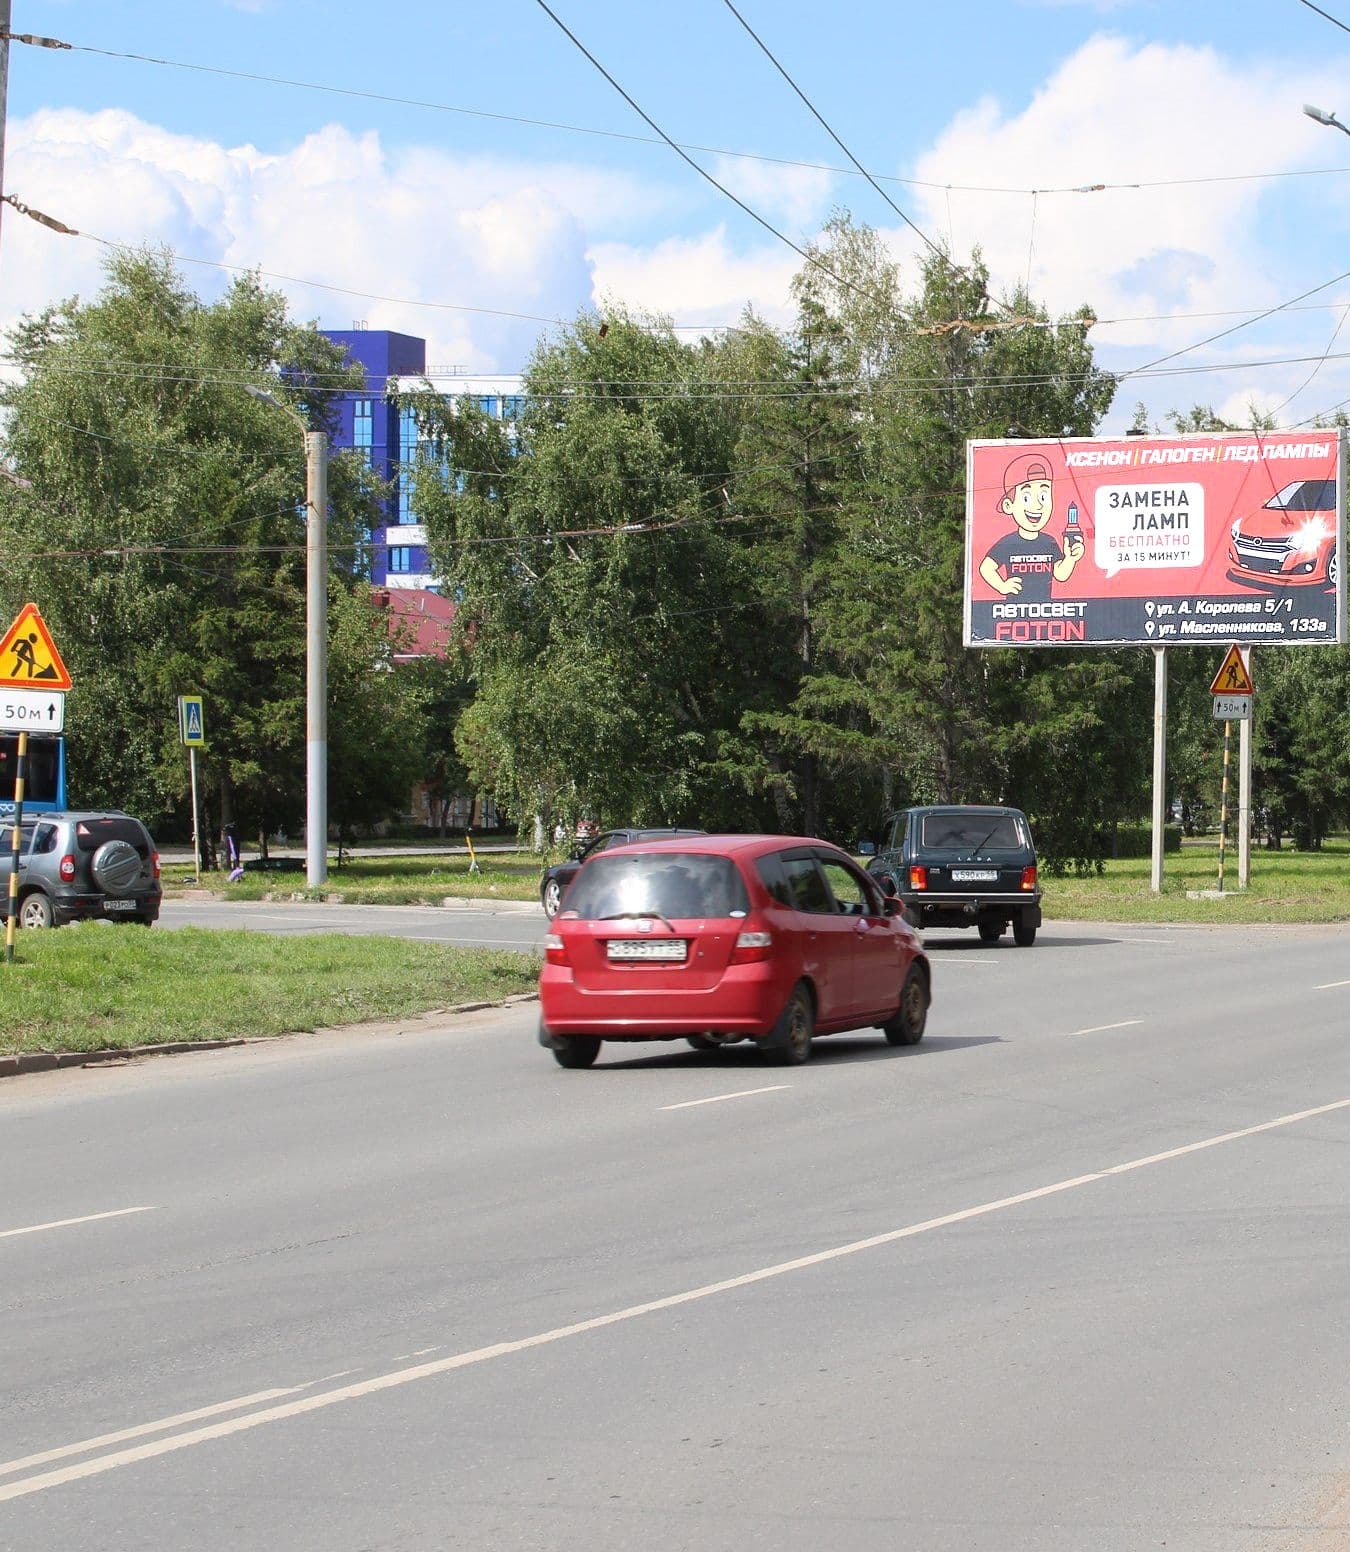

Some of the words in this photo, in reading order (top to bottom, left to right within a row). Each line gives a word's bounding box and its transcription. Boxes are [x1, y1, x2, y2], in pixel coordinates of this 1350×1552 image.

[1065, 451, 1132, 467] КСЕНОН
[1140, 447, 1217, 465] ГАЛОГЕН
[1223, 445, 1260, 462] ЛЕД
[1261, 443, 1330, 460] ЛАМПЫ
[1109, 490, 1189, 508] ЗАМЕНА
[1133, 512, 1188, 530] ЛАМП
[1109, 534, 1190, 548] БЕСПЛАТНО
[1010, 554, 1054, 563] АВТОСВЕТ
[1117, 552, 1130, 562] ЗА
[1134, 552, 1146, 562] 15
[1149, 551, 1190, 561] МИНУТ!
[1011, 563, 1052, 573] FOTON
[992, 602, 1087, 618] АВТОСВЕТ
[1156, 604, 1175, 618] ул.
[1178, 601, 1192, 614] А.
[1195, 601, 1262, 617] Королева
[1264, 599, 1293, 615] 5/1
[996, 620, 1085, 640] FOTON
[1158, 623, 1177, 637] ул.
[1180, 620, 1284, 635] Масленникова,
[1289, 618, 1327, 632] 133а
[5, 704, 41, 719] 50м
[1223, 703, 1240, 712] 50м
